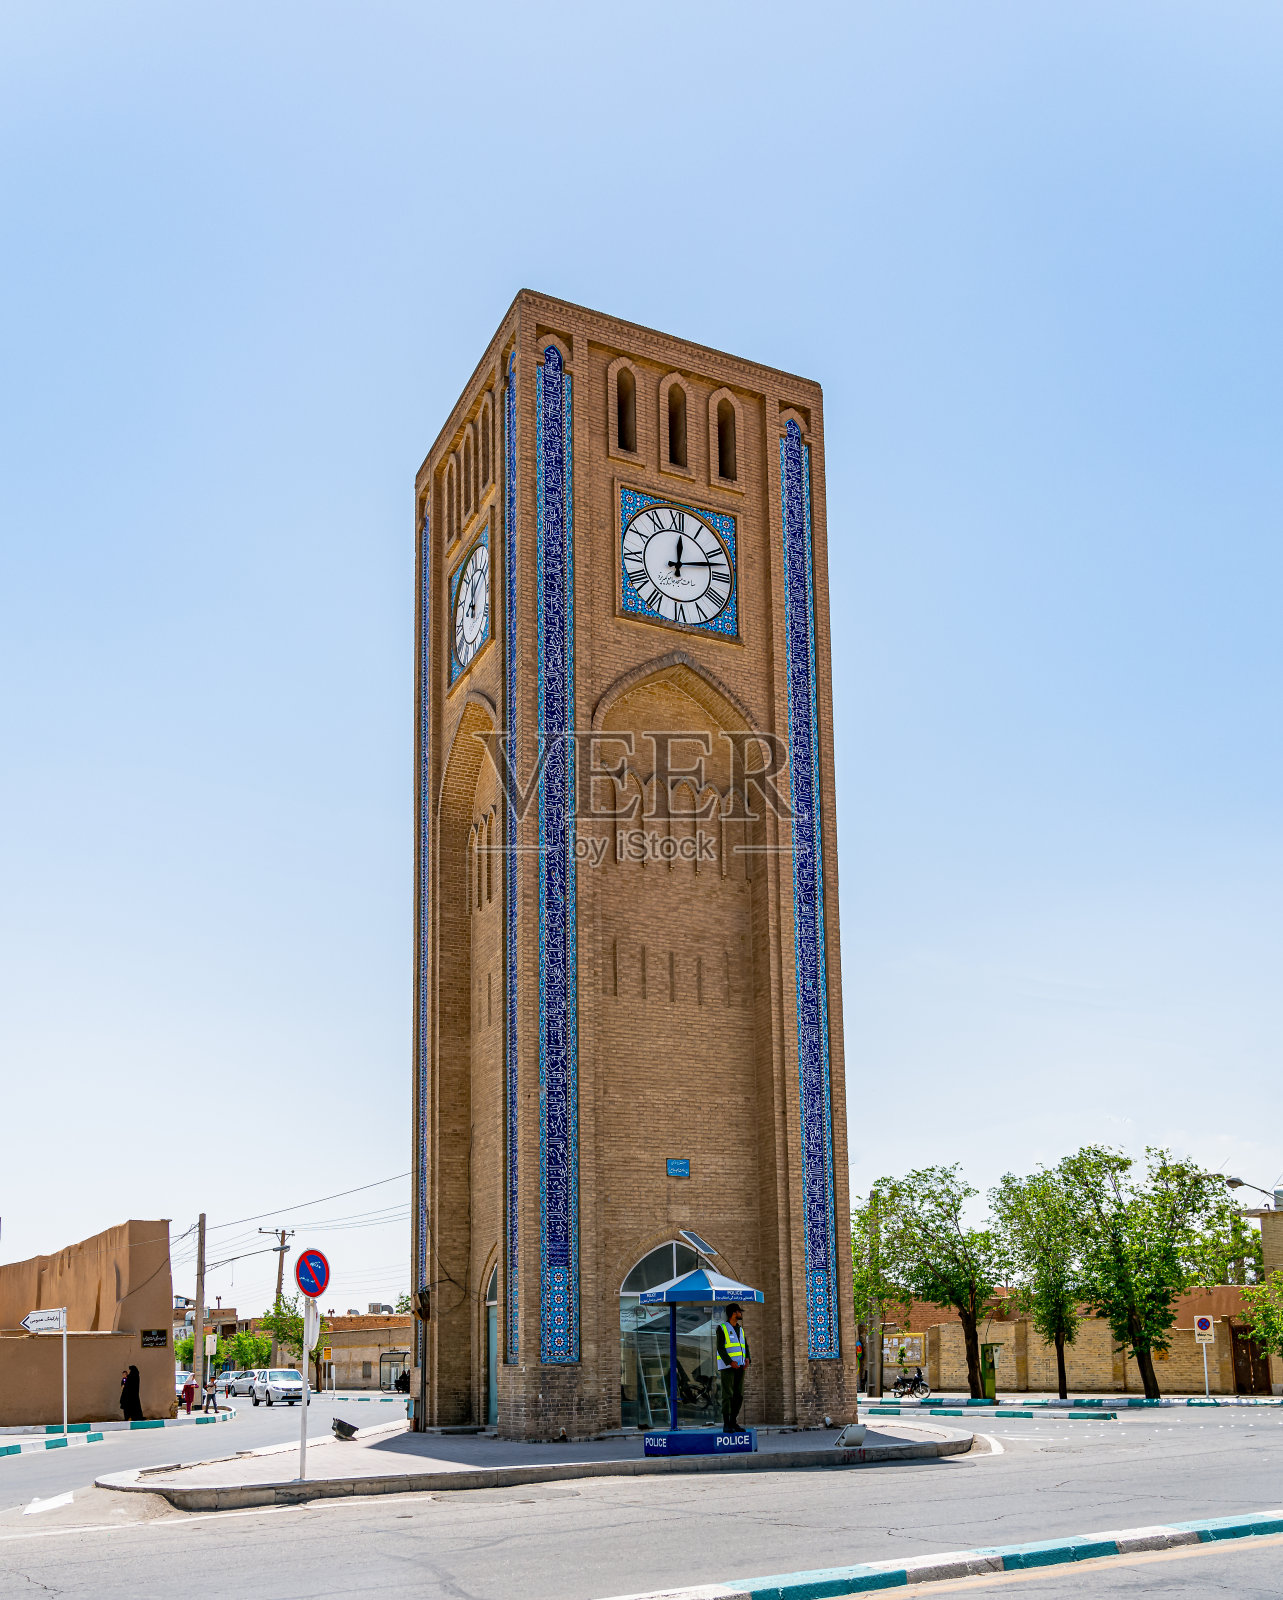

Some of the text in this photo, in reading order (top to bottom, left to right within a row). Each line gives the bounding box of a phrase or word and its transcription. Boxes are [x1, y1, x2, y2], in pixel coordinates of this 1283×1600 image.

[645, 510, 665, 532] XI
[669, 510, 685, 532] XII
[629, 523, 649, 544] X
[694, 525, 704, 540] I
[706, 547, 723, 559] II
[712, 571, 730, 583] III
[674, 602, 687, 622] VI
[695, 602, 708, 621] V
[645, 1437, 667, 1448] POLICE
[716, 1435, 750, 1447] POLICE
